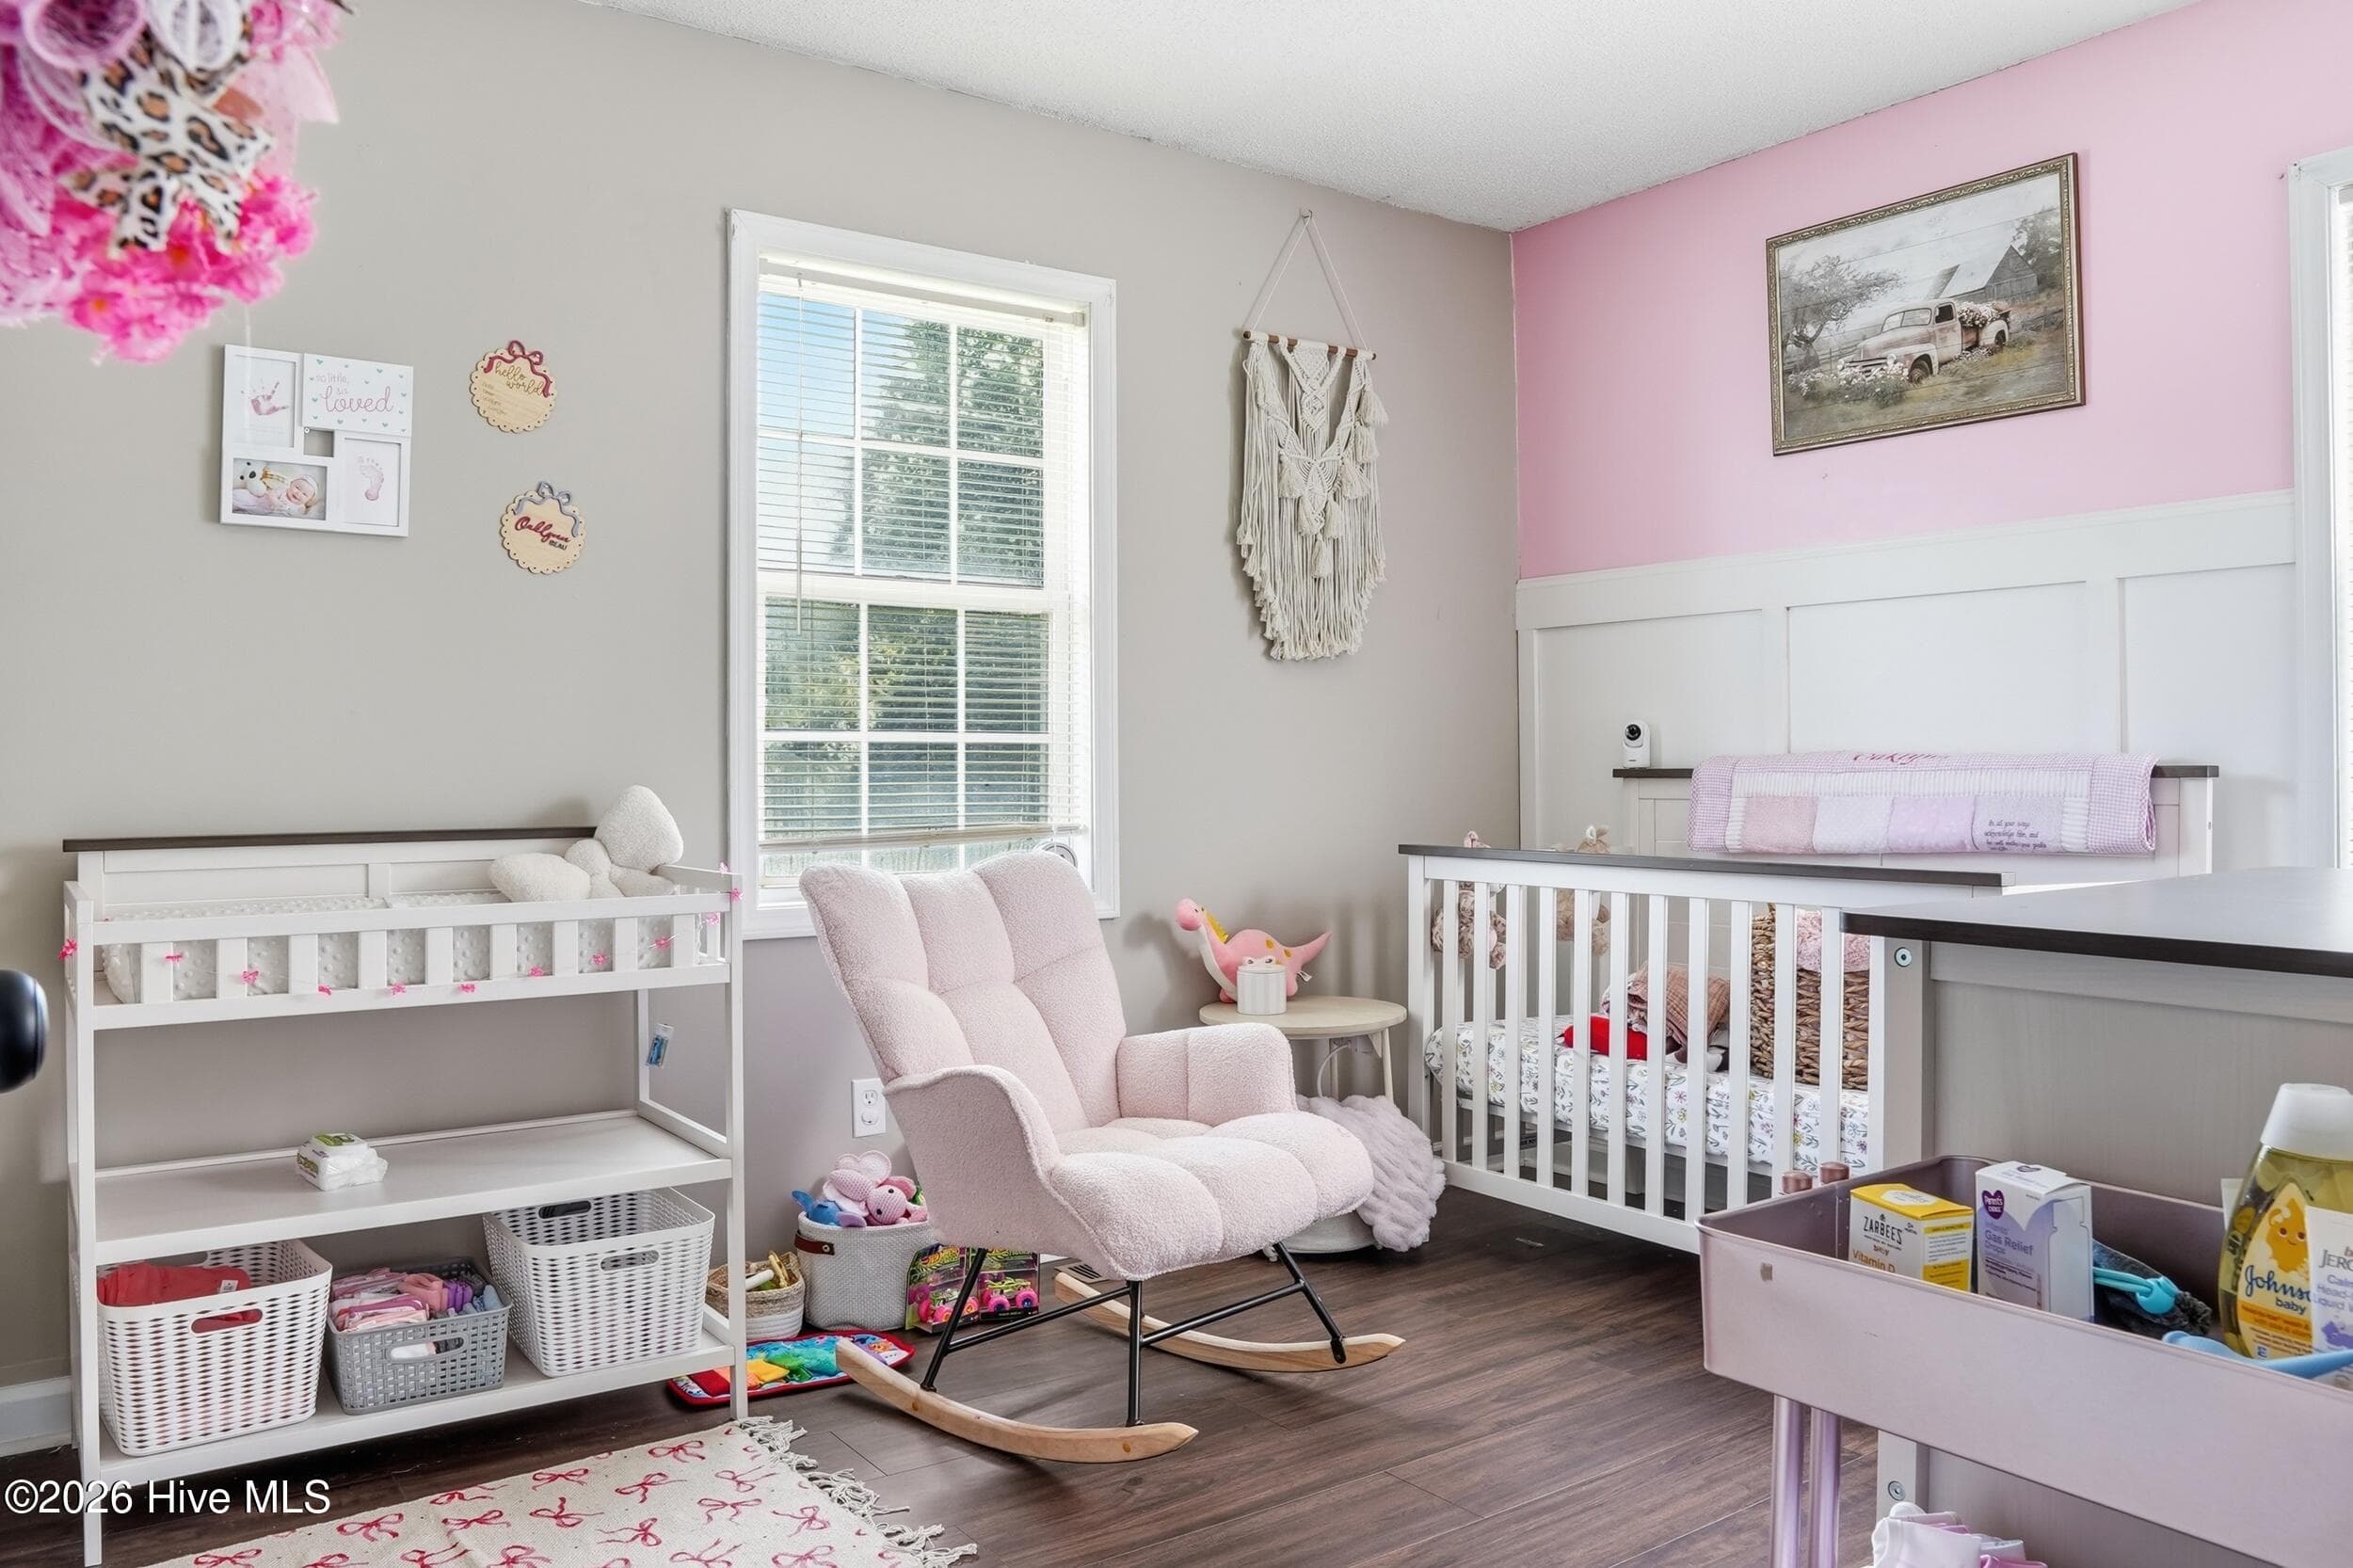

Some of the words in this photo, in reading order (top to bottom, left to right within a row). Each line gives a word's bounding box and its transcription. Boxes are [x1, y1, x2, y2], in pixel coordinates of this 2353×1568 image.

[495, 360, 526, 382] hello
[506, 378, 544, 395] world
[320, 385, 394, 412] loved
[1985, 1229, 2003, 1244] Gas
[2004, 1236, 2033, 1256] Relief
[1852, 1249, 1887, 1271] Vitamin
[2275, 1296, 2307, 1316] baby
